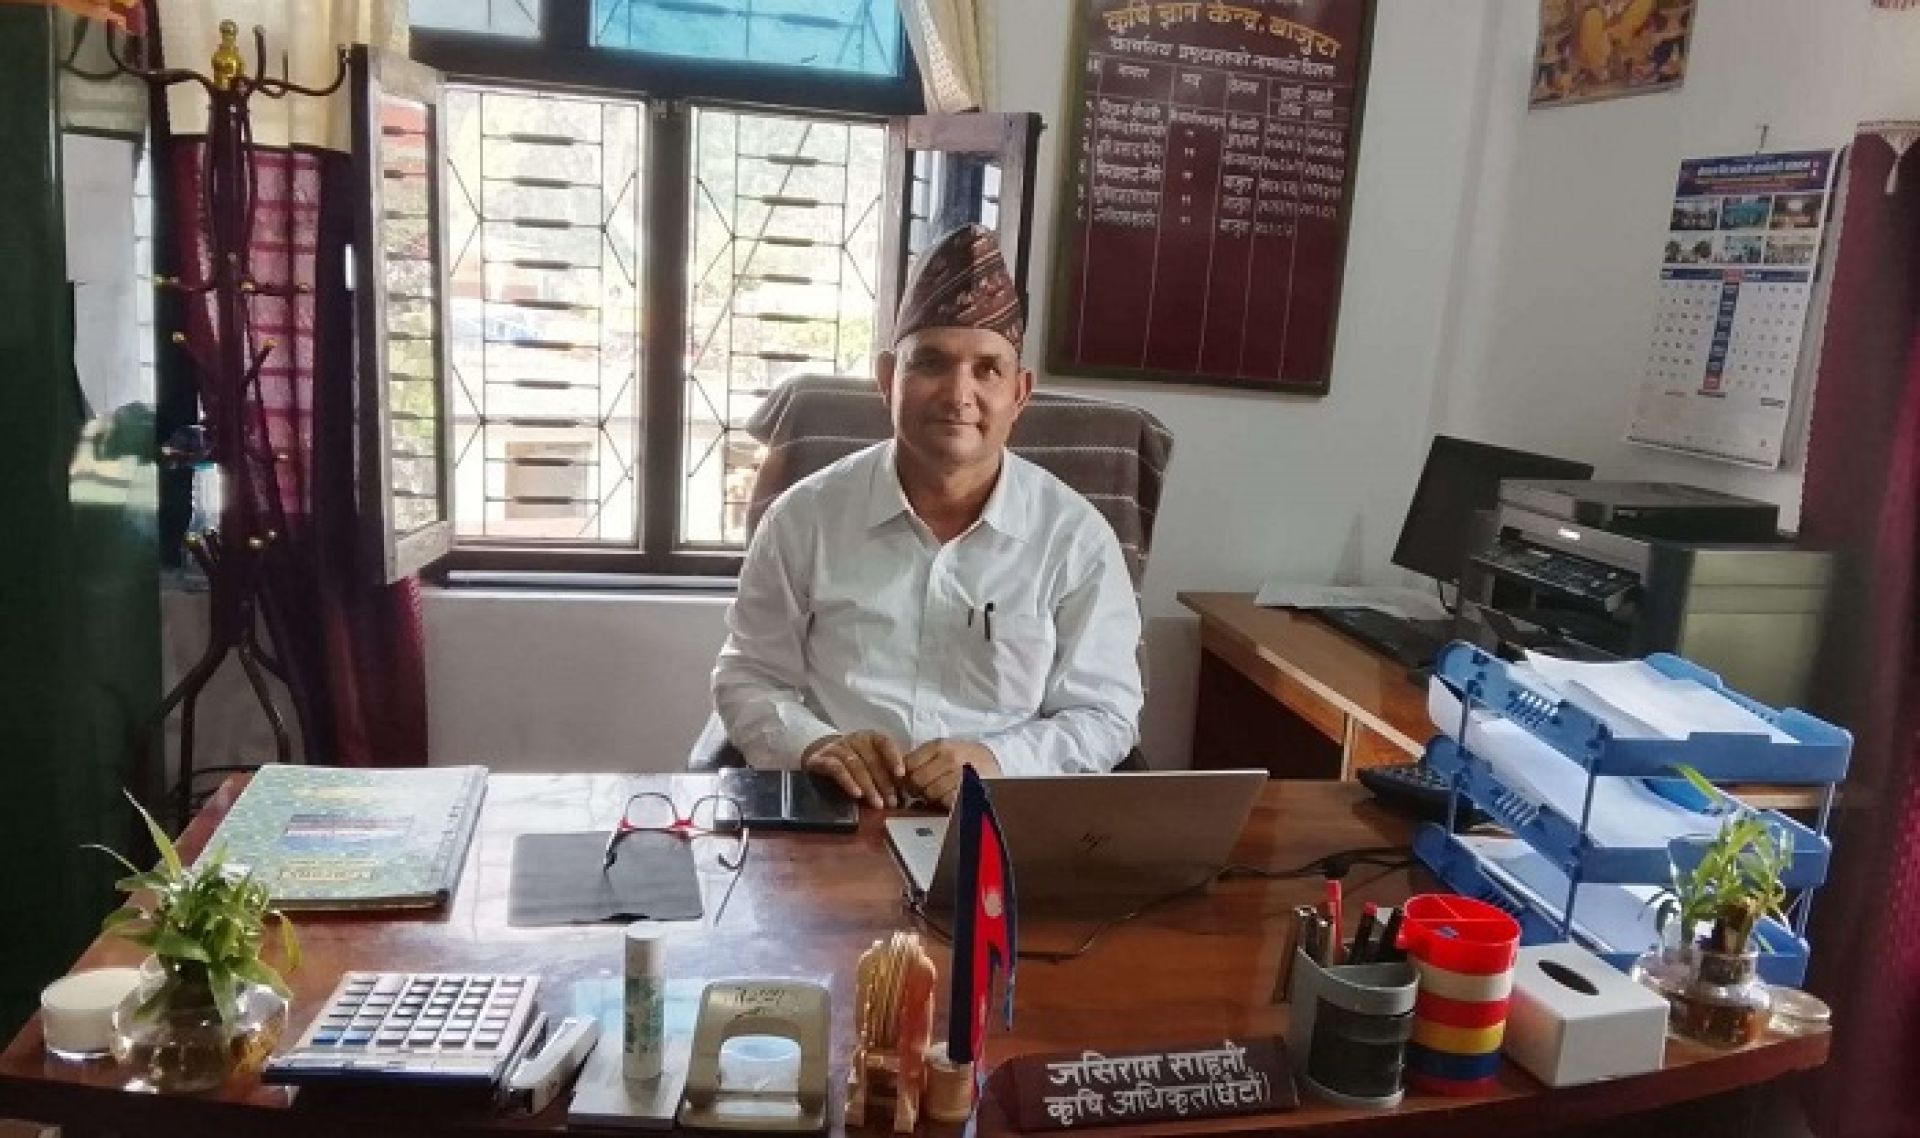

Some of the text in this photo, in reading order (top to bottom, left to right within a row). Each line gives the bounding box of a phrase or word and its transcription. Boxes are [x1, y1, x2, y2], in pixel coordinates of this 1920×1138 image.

[1102, 0, 1150, 34] कृषि
[1045, 1048, 1163, 1086] जसिराम
[1042, 1088, 1104, 1127] कृषि
